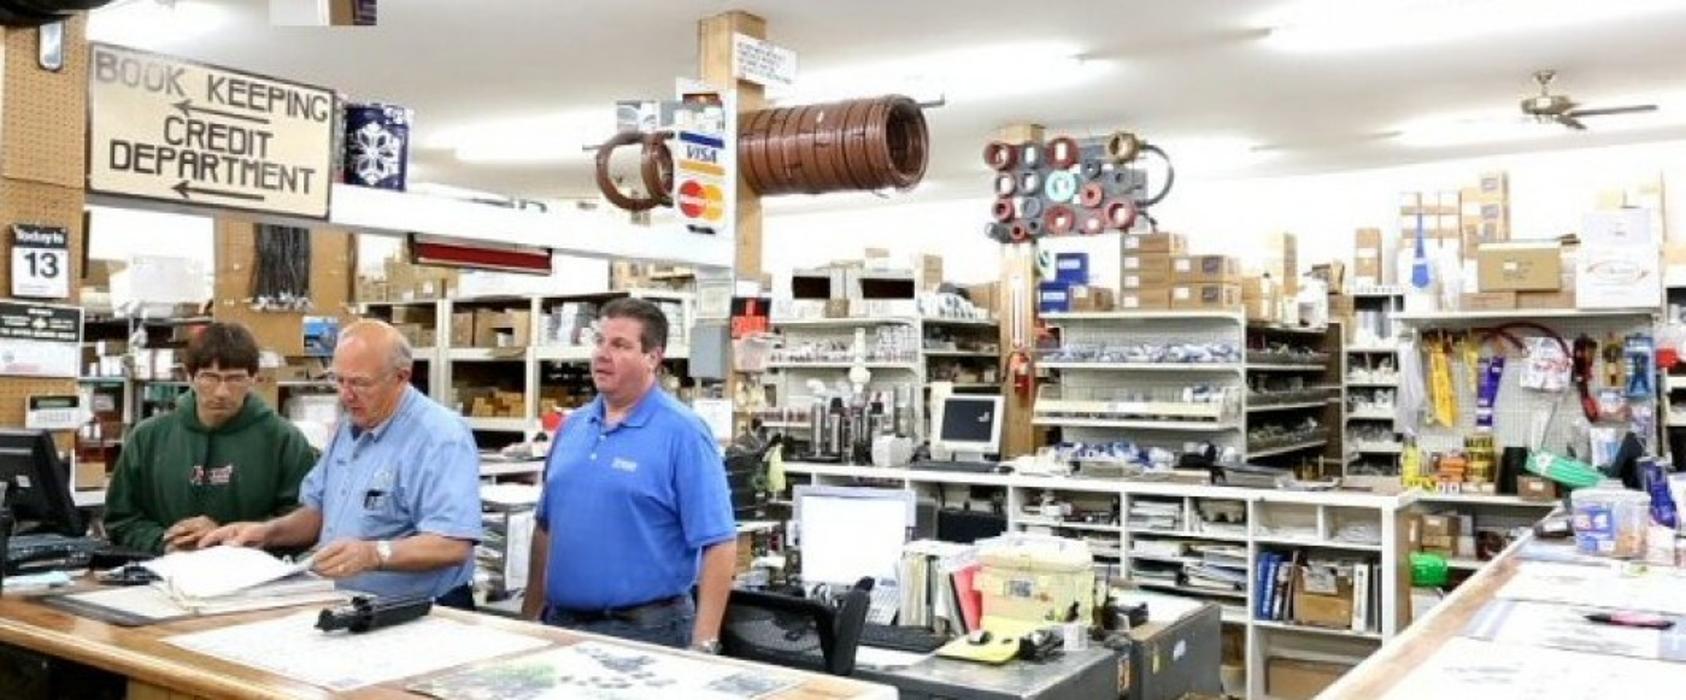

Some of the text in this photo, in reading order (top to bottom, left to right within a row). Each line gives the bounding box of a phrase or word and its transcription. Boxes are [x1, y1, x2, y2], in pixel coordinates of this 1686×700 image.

[95, 51, 328, 122] BOOK KEEPING
[164, 115, 274, 159] CREDIT
[686, 146, 717, 164] VISA
[109, 139, 315, 194] DEPARTMENT
[24, 252, 59, 278] 13
